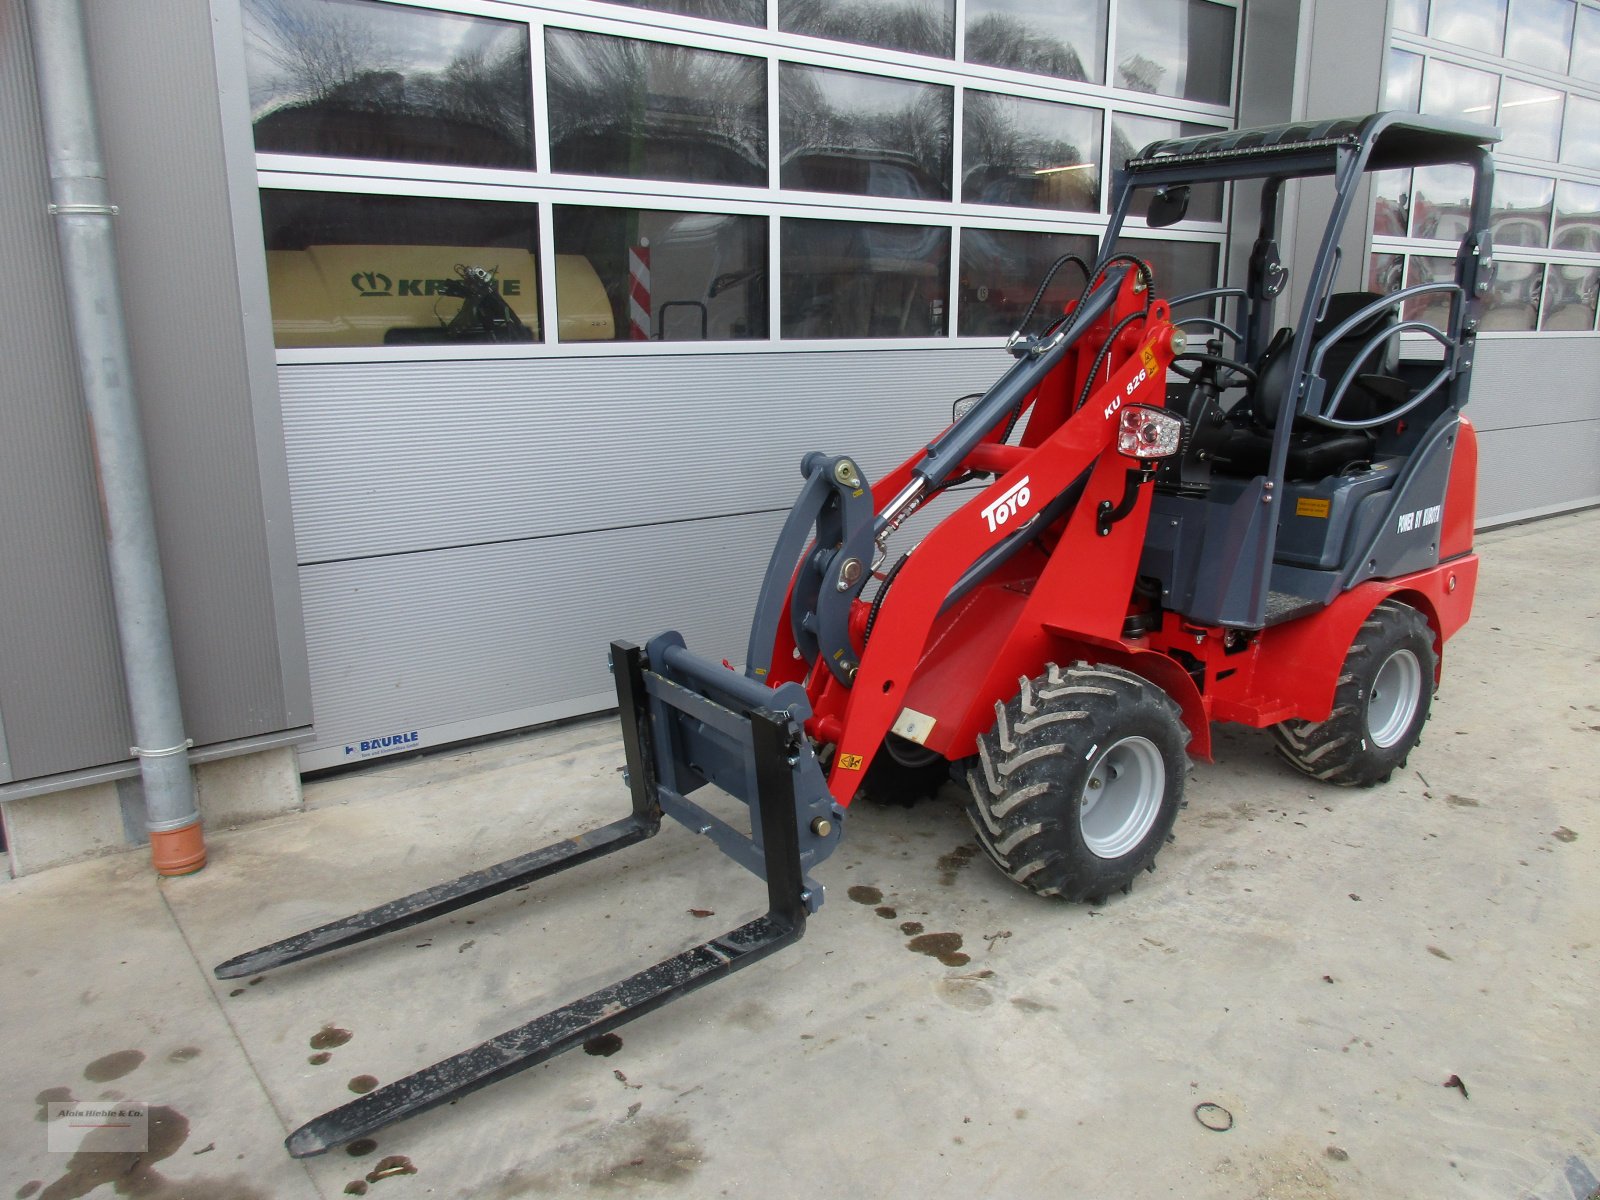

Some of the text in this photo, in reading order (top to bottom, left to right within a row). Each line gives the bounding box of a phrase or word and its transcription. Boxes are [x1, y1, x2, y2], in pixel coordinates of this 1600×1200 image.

[399, 280, 521, 296] KRE
[1104, 369, 1147, 420] KU 826
[981, 475, 1031, 533] TOYO
[1397, 512, 1415, 534] POWER
[1415, 510, 1423, 528] BY
[361, 731, 419, 751] BÄURLE
